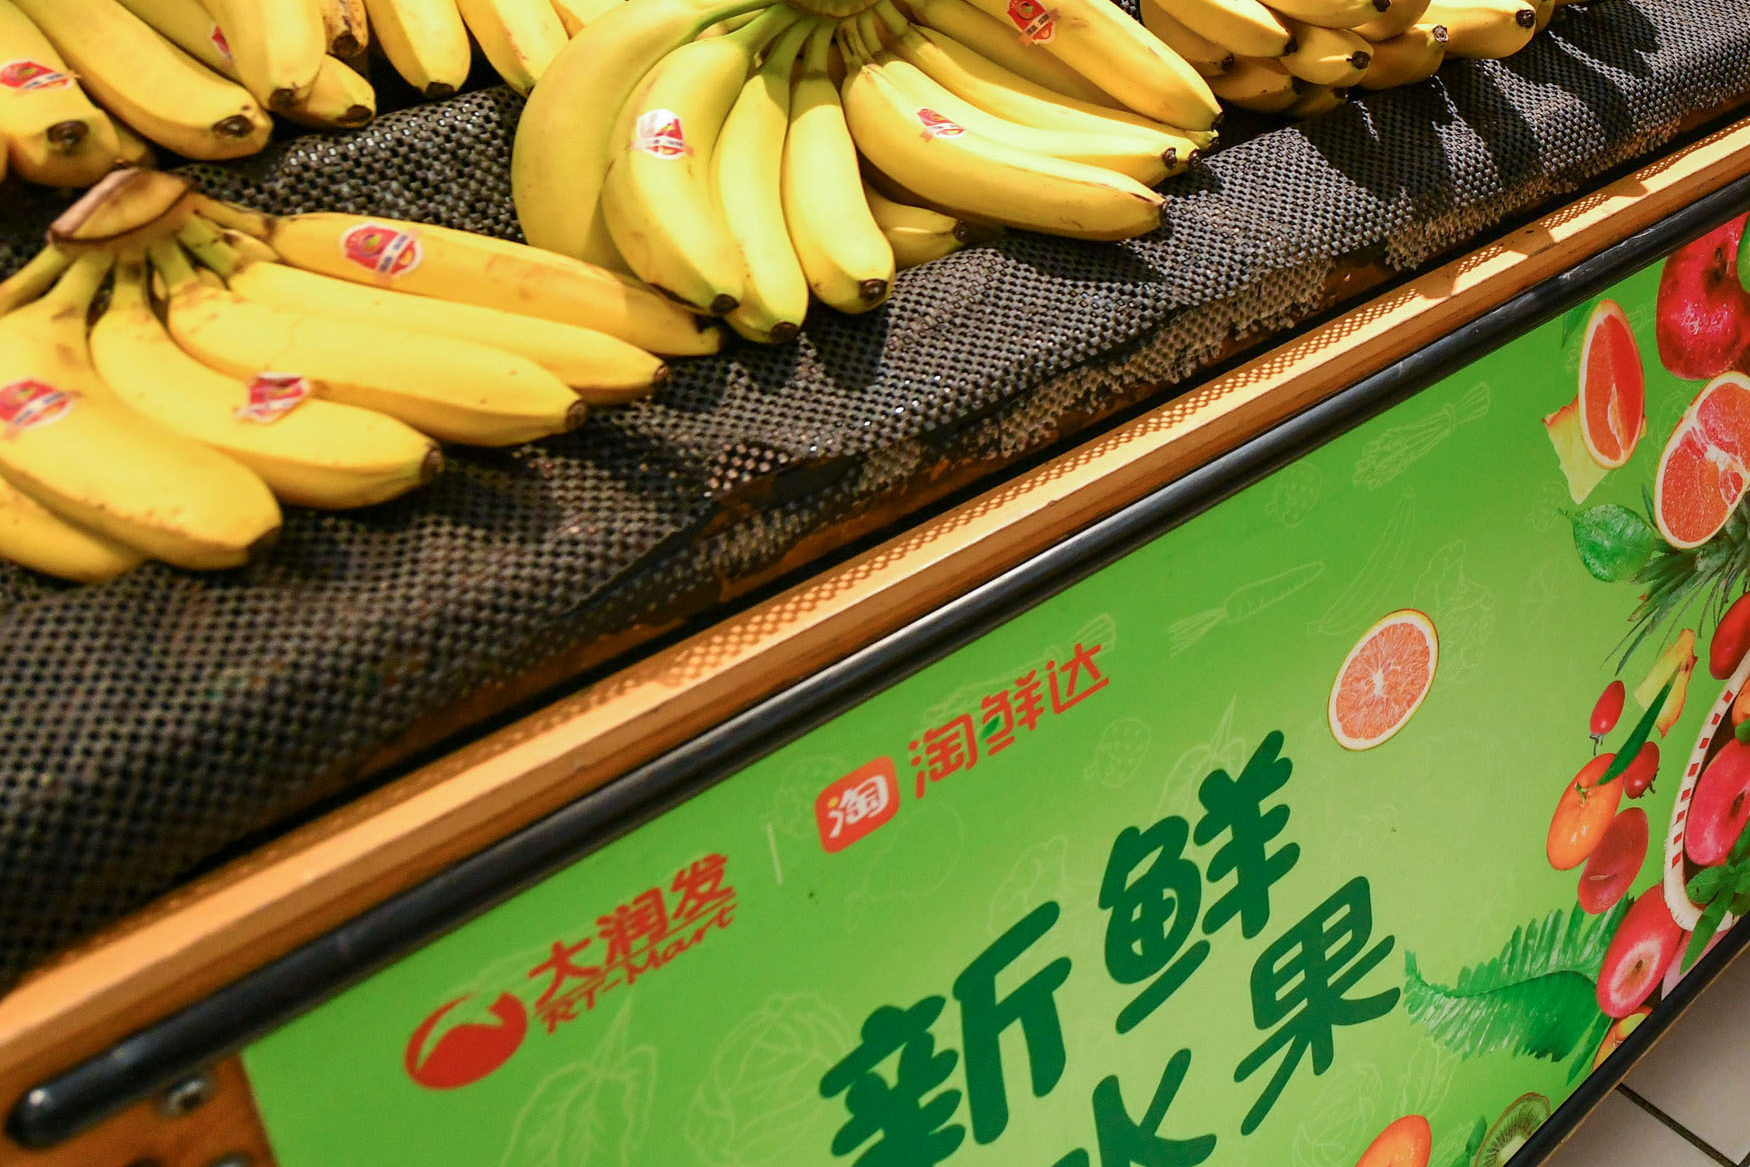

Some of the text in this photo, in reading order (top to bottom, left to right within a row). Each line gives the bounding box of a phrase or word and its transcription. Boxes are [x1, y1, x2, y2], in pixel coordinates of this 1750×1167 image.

[908, 643, 1110, 799] 淘鲜达
[829, 774, 889, 838] 淘
[528, 852, 731, 1005] 大润发
[536, 898, 737, 1034] RT-Mart
